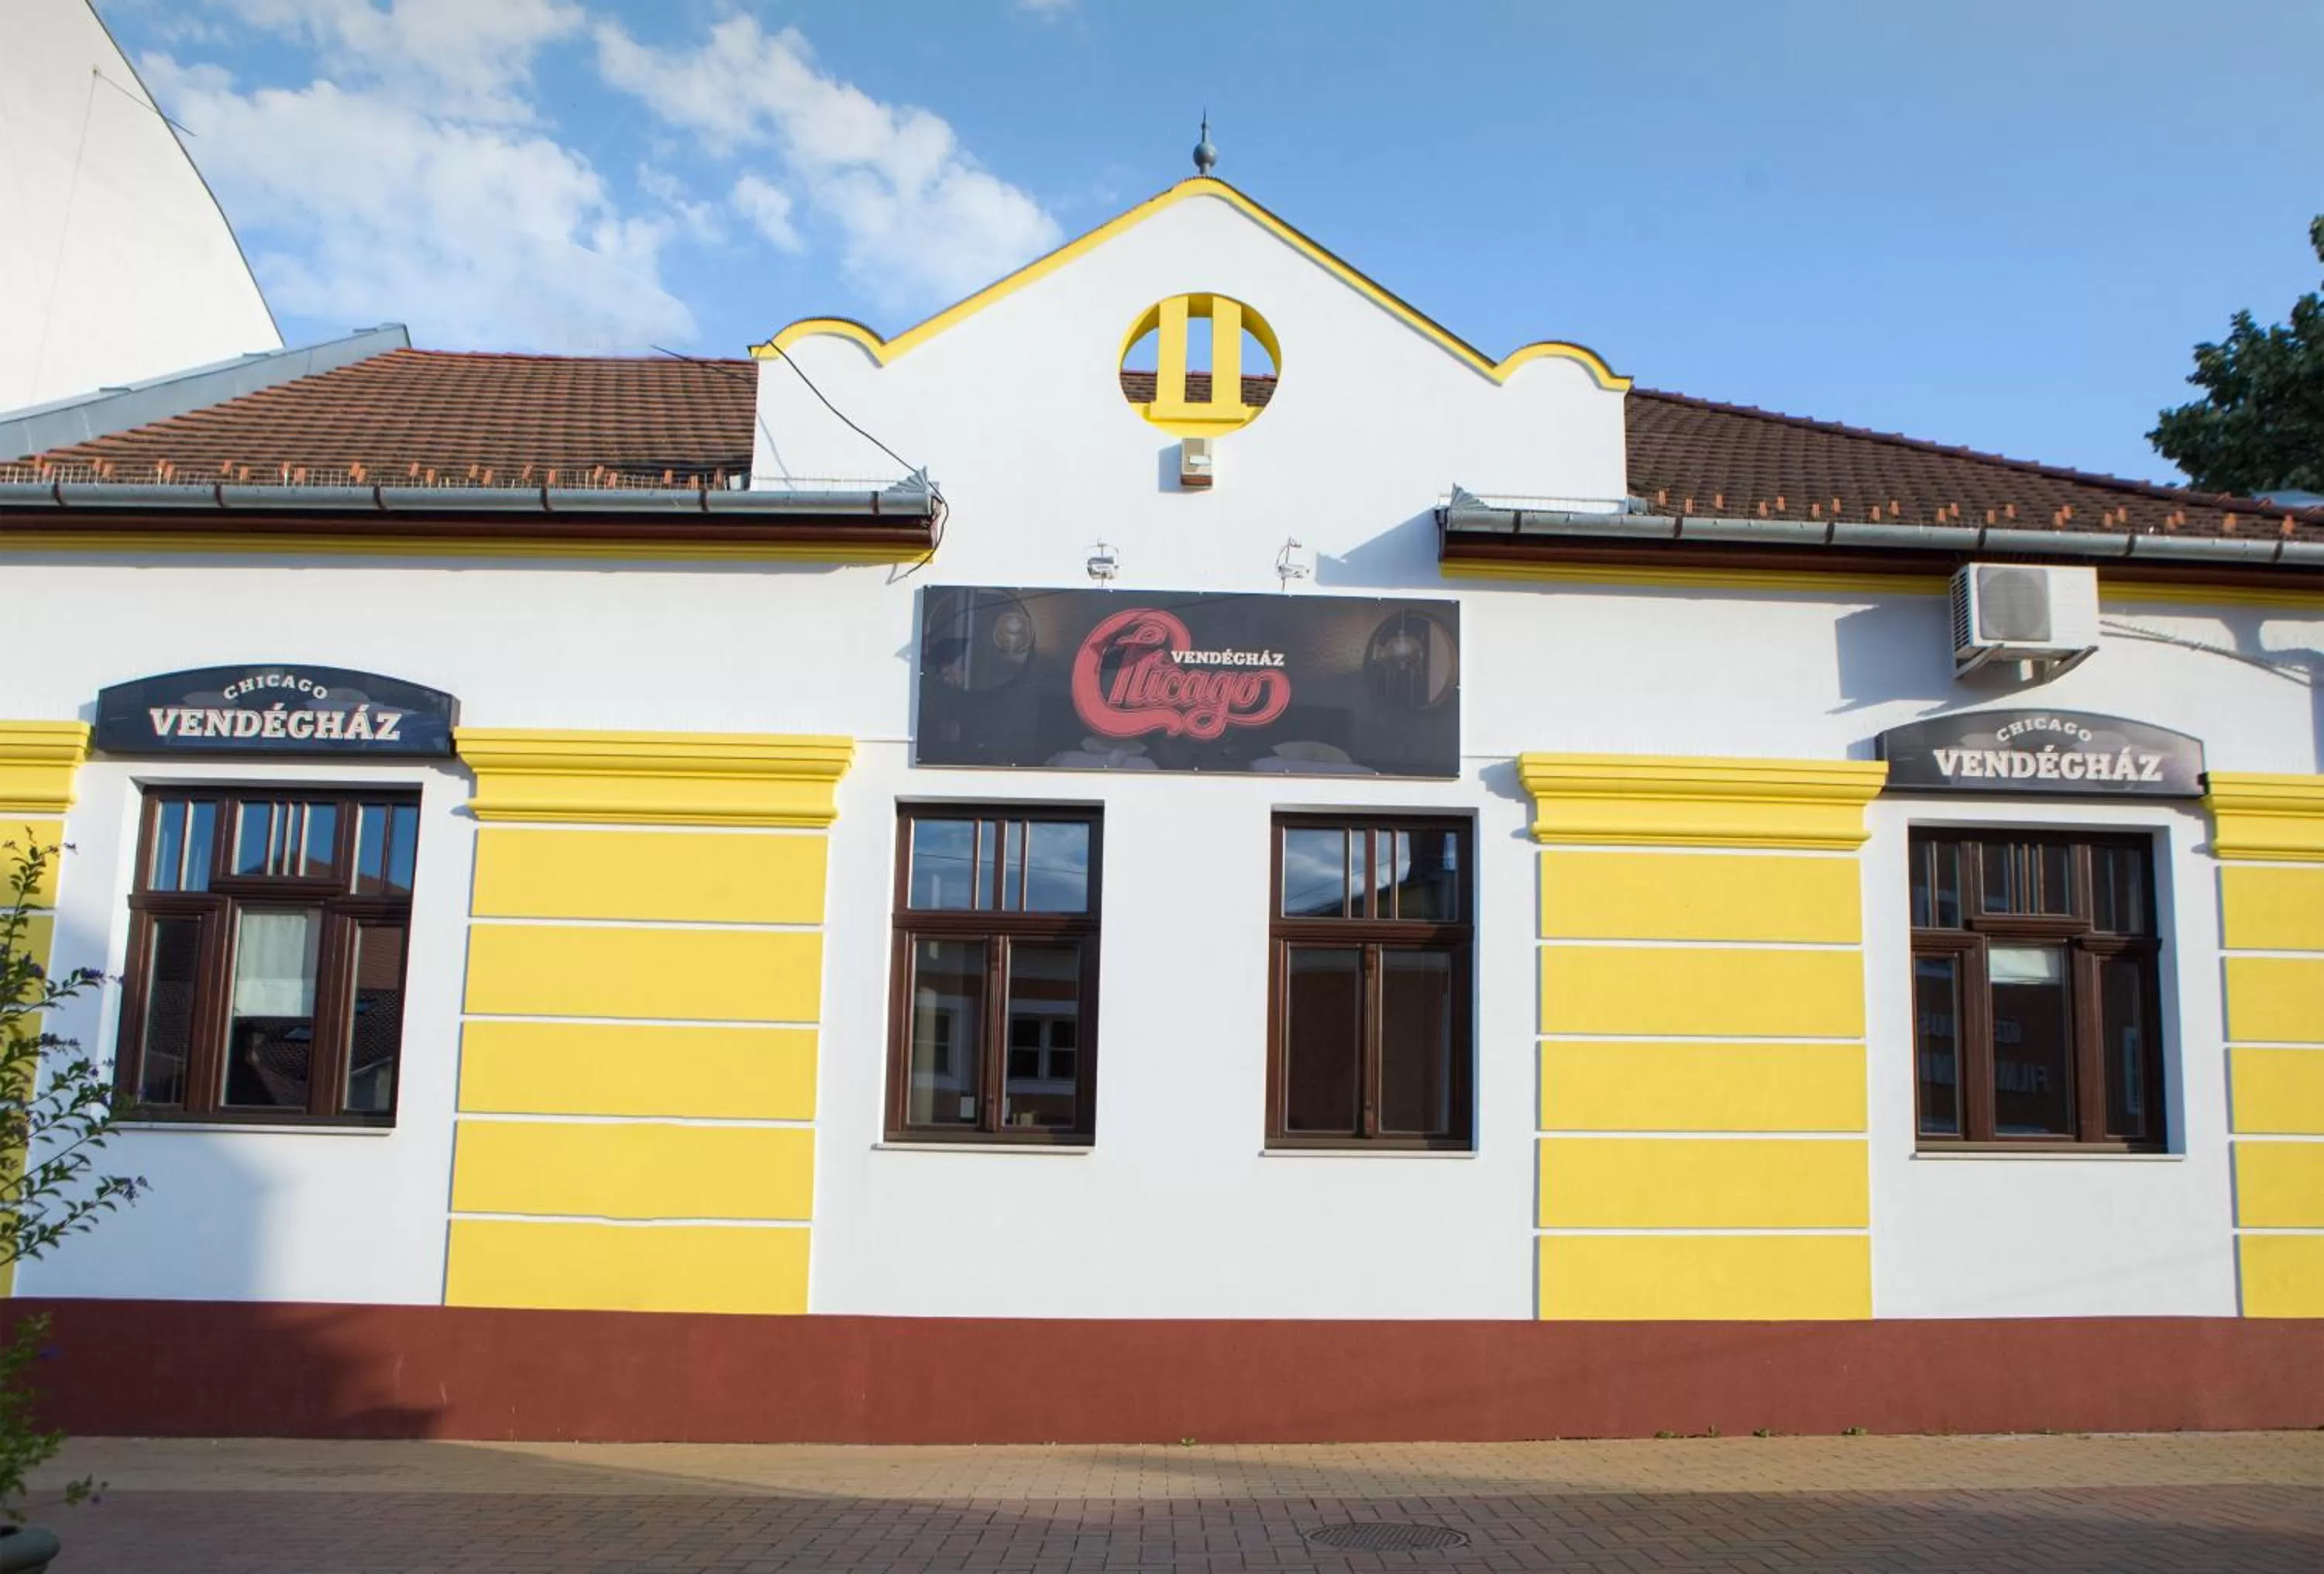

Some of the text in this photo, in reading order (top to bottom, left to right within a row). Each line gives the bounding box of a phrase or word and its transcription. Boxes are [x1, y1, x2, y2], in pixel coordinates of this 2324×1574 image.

[1071, 607, 1291, 740] Chicago
[1171, 648, 1285, 667] VENDÉGHÁZ
[222, 674, 329, 700] CHICAGO
[150, 703, 403, 741] VENDÉGHÁZ
[1996, 717, 2092, 742] CHICAGO
[1933, 744, 2164, 782] VENDÉGHÁZ
